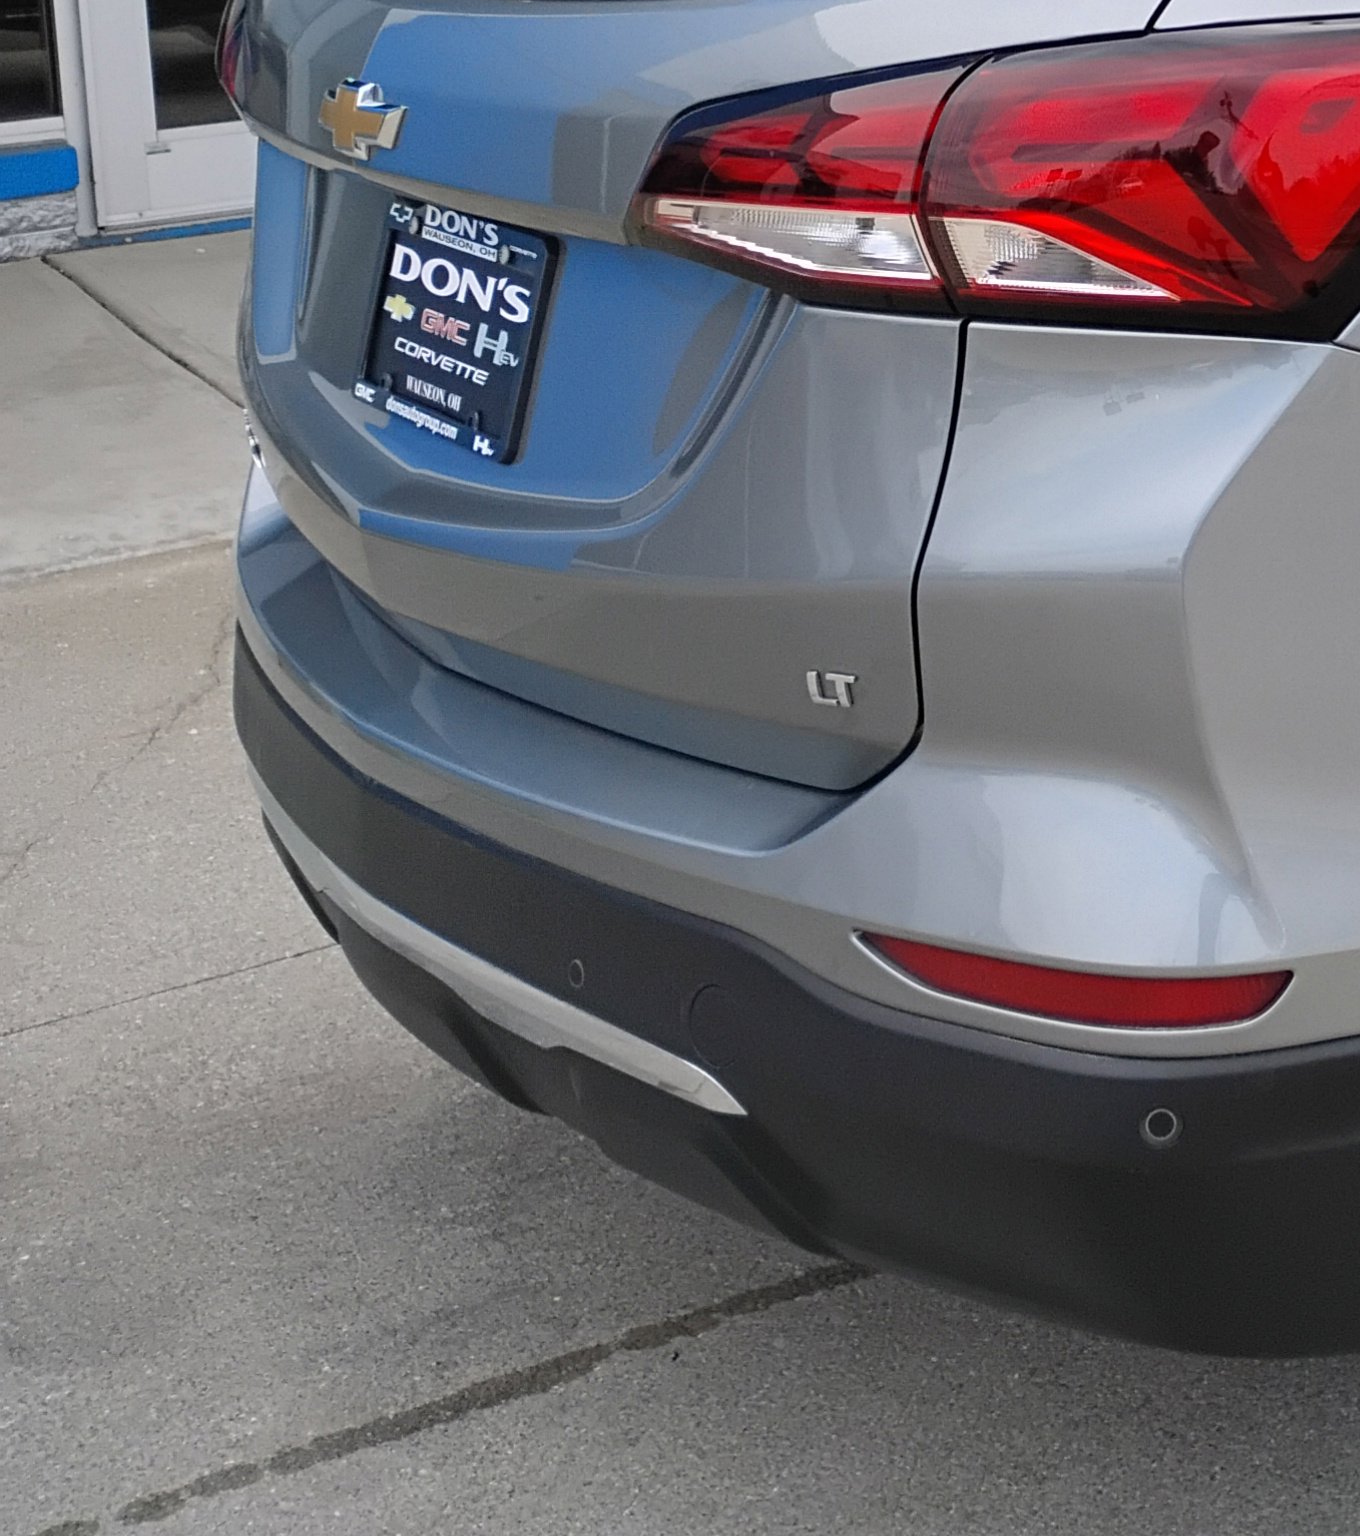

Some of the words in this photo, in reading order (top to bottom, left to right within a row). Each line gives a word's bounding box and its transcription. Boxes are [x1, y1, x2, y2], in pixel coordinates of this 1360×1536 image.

[423, 227, 476, 253] WAUSEON,
[479, 247, 497, 260] OH
[424, 204, 499, 247] DON'S
[389, 243, 531, 323] DON'S
[420, 308, 471, 346] GMC
[394, 337, 490, 386] CORVETTE
[354, 383, 376, 403] GMC
[406, 375, 448, 410] WAUSEON,
[448, 394, 462, 412] OH
[386, 395, 458, 440] donsautogroup.com
[806, 669, 858, 707] LT
